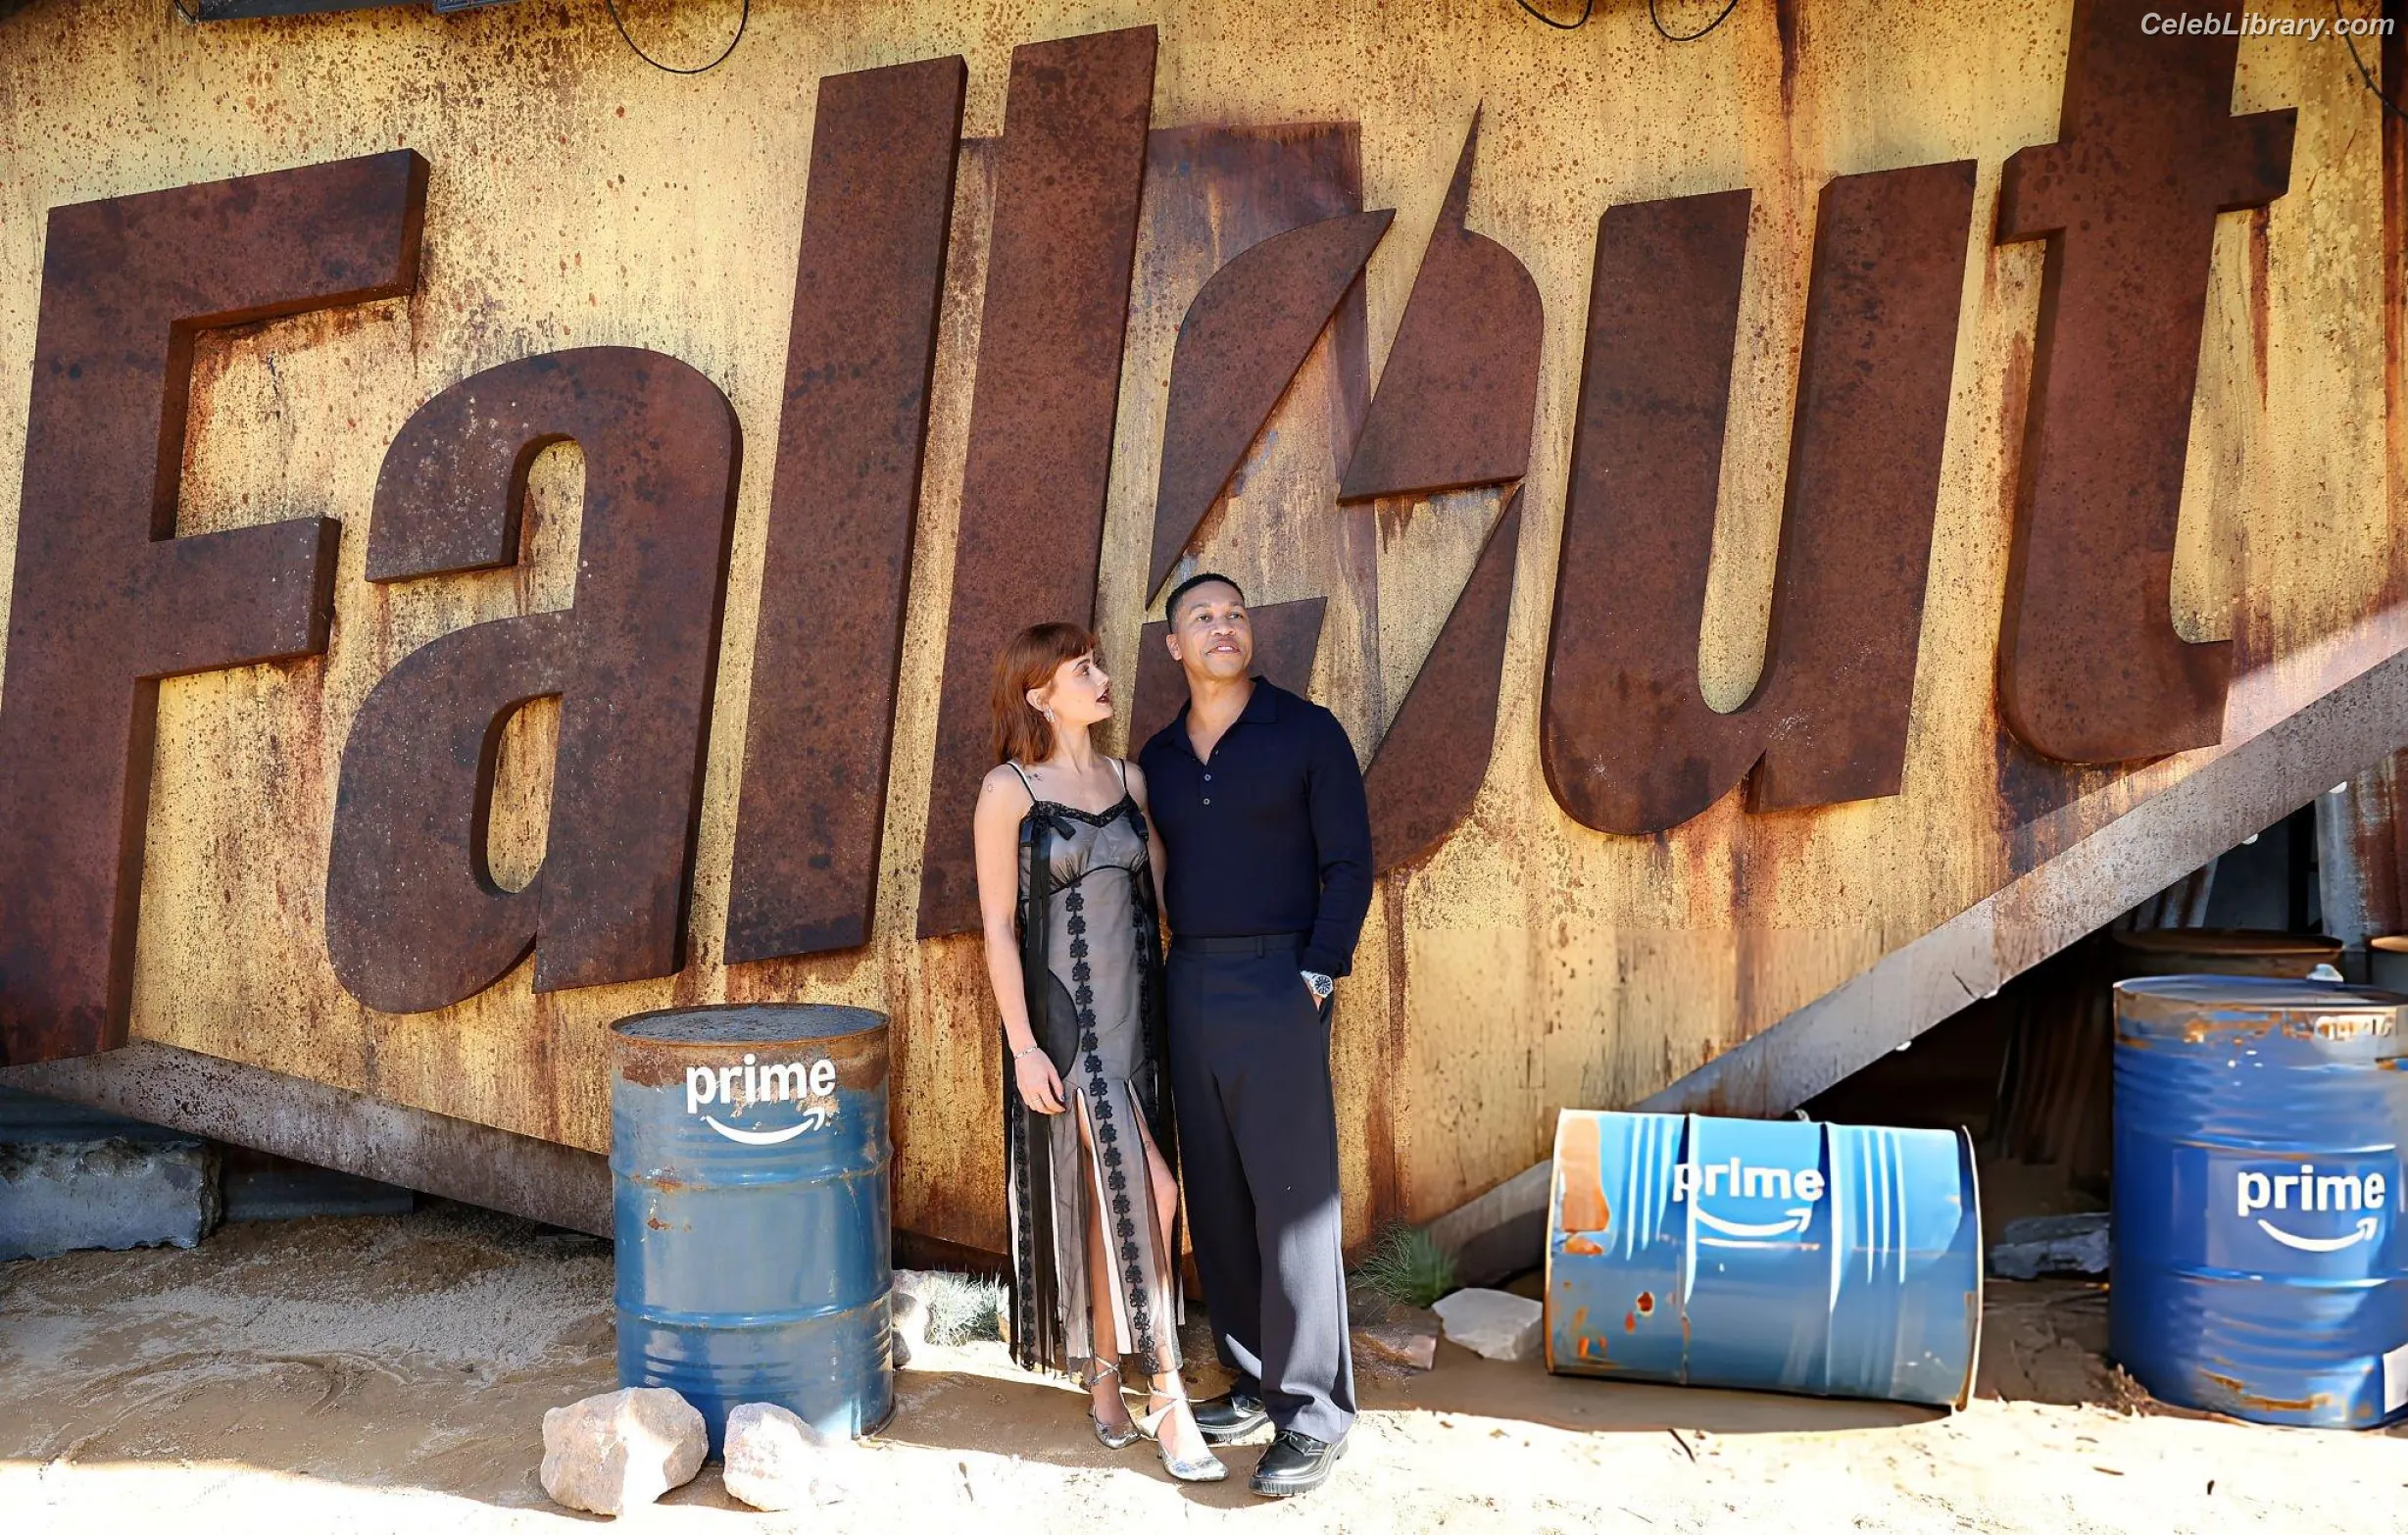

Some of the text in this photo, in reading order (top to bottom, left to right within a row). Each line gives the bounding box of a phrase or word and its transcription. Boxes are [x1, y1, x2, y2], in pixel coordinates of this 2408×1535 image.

[0, 0, 2297, 1068] Fallout
[686, 1053, 836, 1114] prime
[1672, 1156, 1826, 1203] prime
[2237, 1164, 2385, 1217] prime
